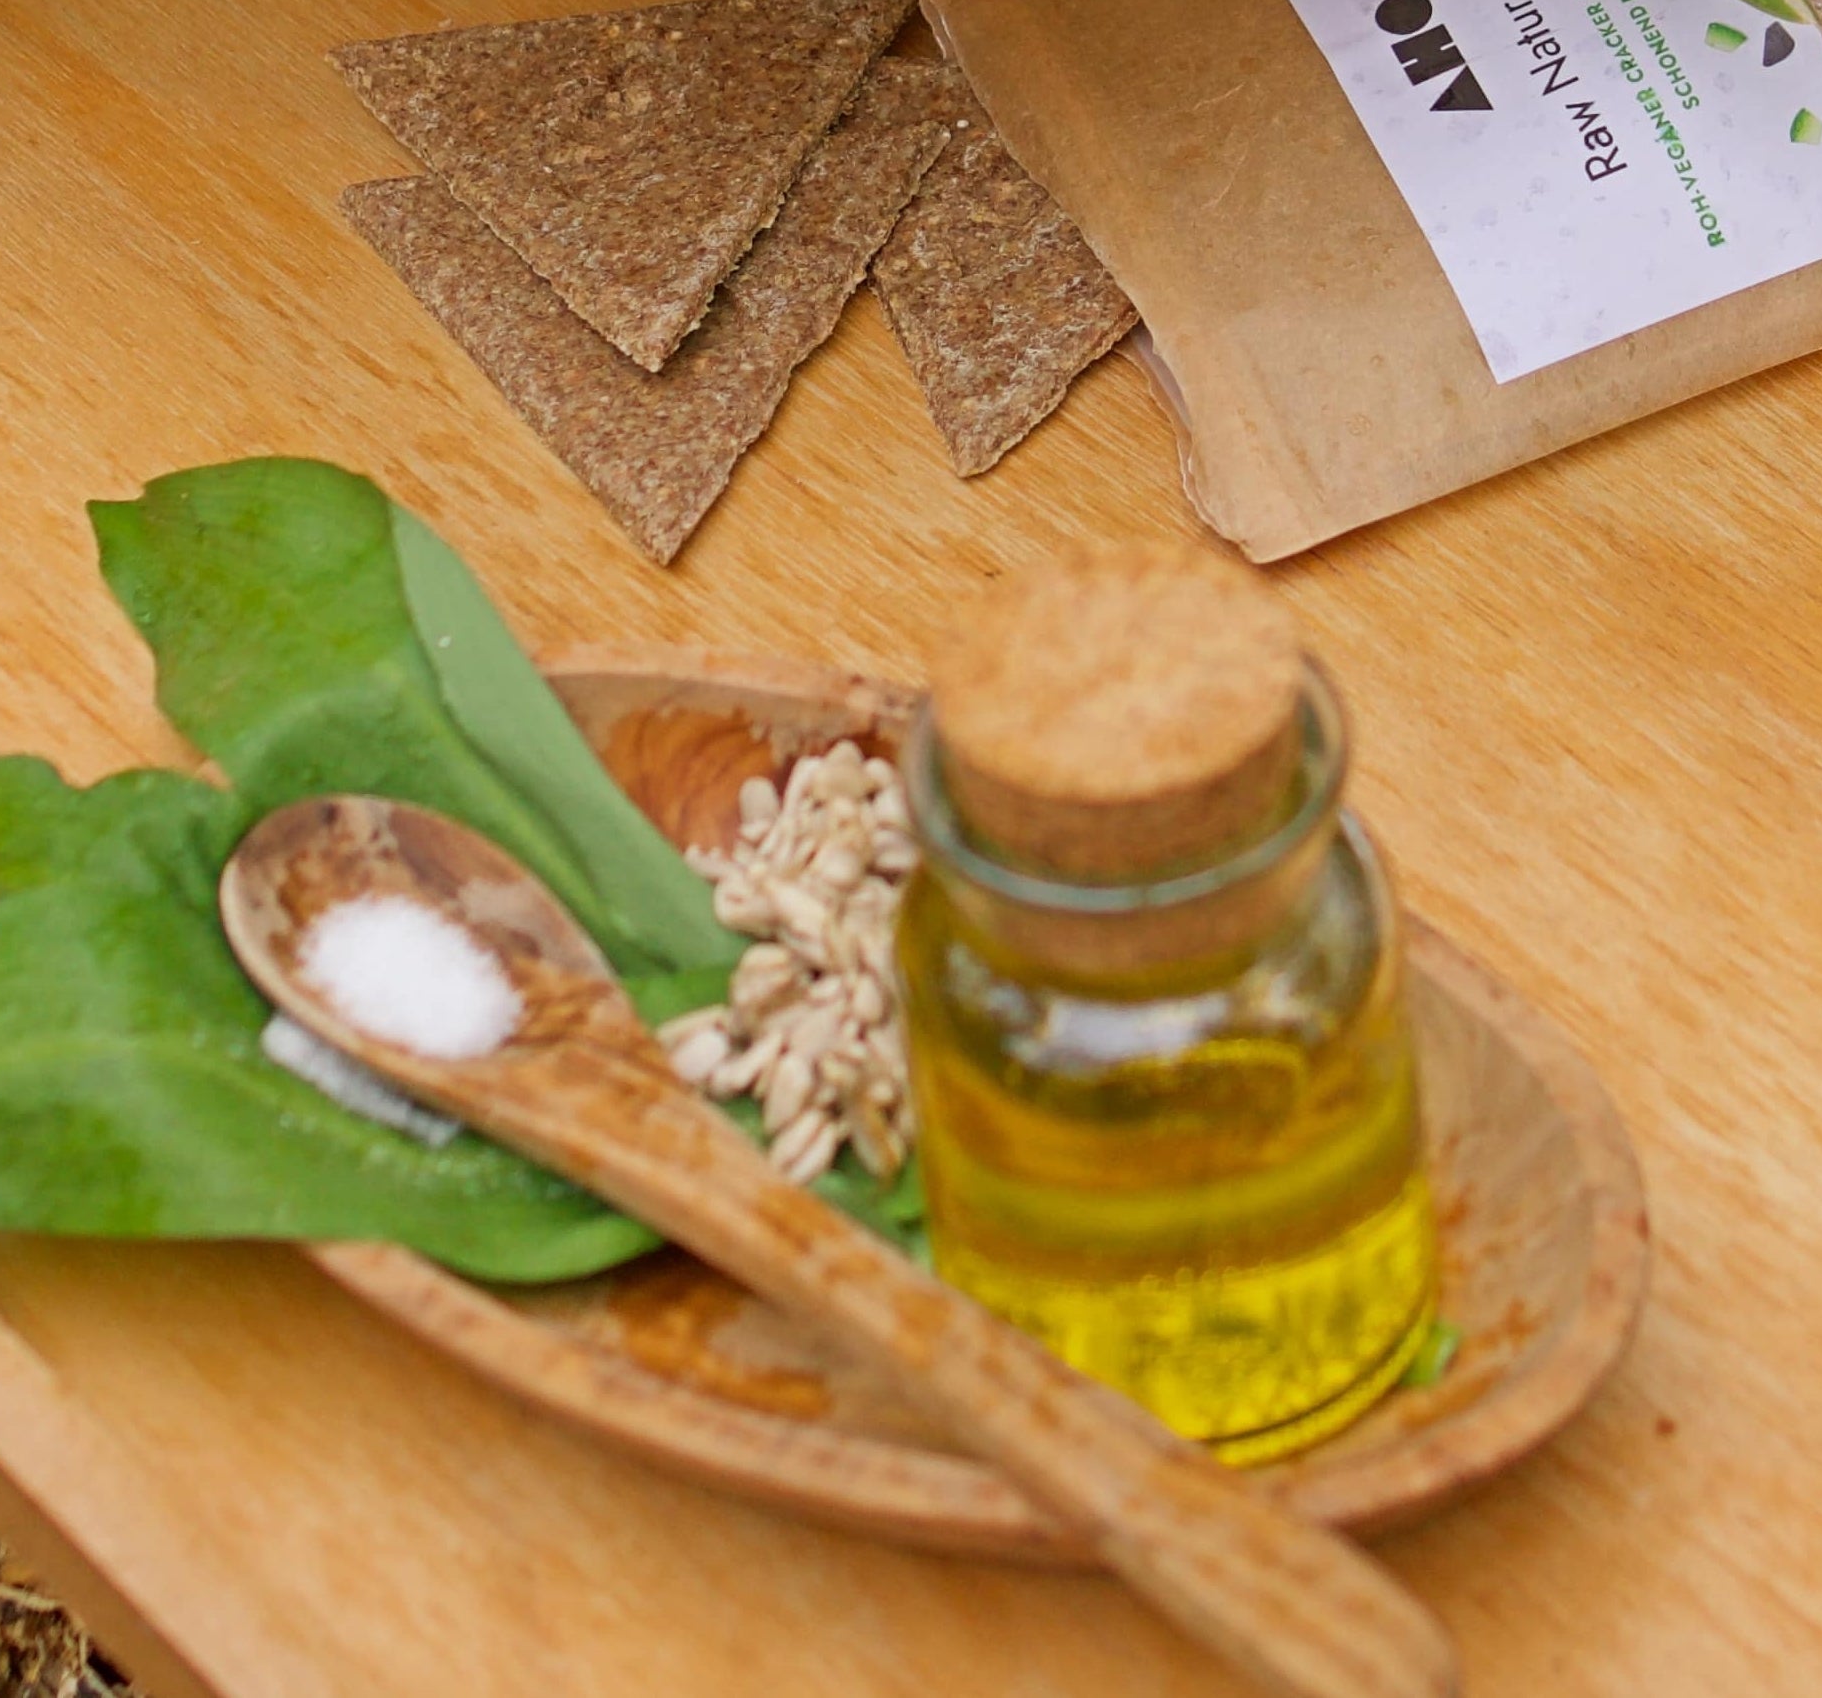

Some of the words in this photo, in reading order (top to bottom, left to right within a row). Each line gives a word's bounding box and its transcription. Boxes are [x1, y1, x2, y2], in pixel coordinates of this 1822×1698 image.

[1505, 0, 1578, 96] Natur
[1587, 2, 1644, 83] CRACKER
[1629, 5, 1699, 110] SCHONEND
[1566, 101, 1627, 181] Raw
[1636, 87, 1725, 247] ROH-VEGANER
